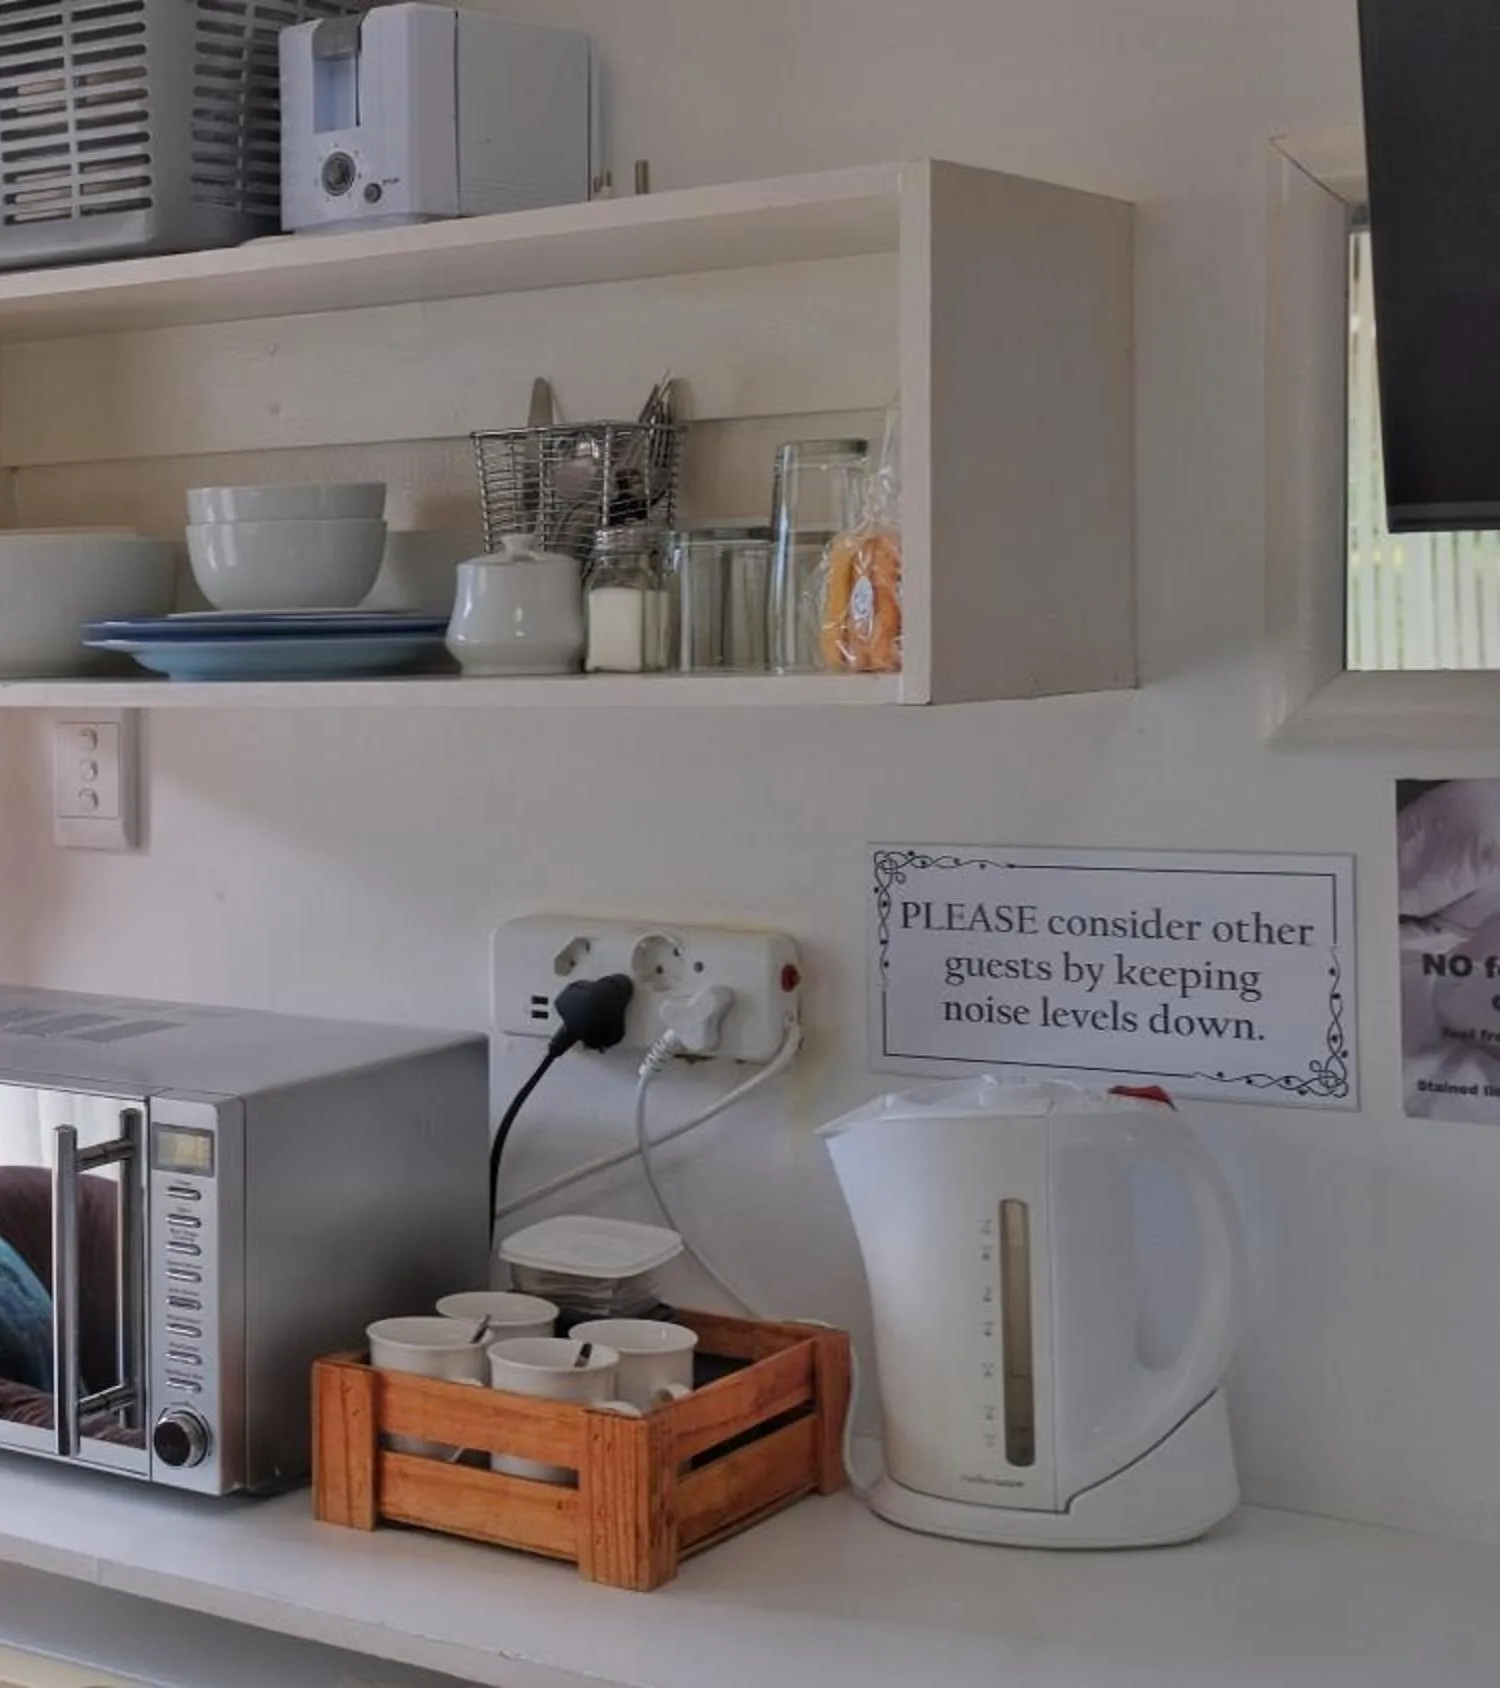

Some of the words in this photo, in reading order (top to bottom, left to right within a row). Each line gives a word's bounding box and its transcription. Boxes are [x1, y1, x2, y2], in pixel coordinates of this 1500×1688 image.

[901, 901, 1038, 935] PLEASE
[1047, 907, 1202, 941] consider
[1212, 911, 1314, 946] other
[945, 956, 1052, 986] guests
[1063, 951, 1104, 993] by
[1115, 953, 1263, 1001] keeping
[1422, 953, 1473, 977] NO
[944, 996, 1030, 1025] noise
[1041, 997, 1138, 1032] levels
[1149, 1003, 1265, 1041] down.
